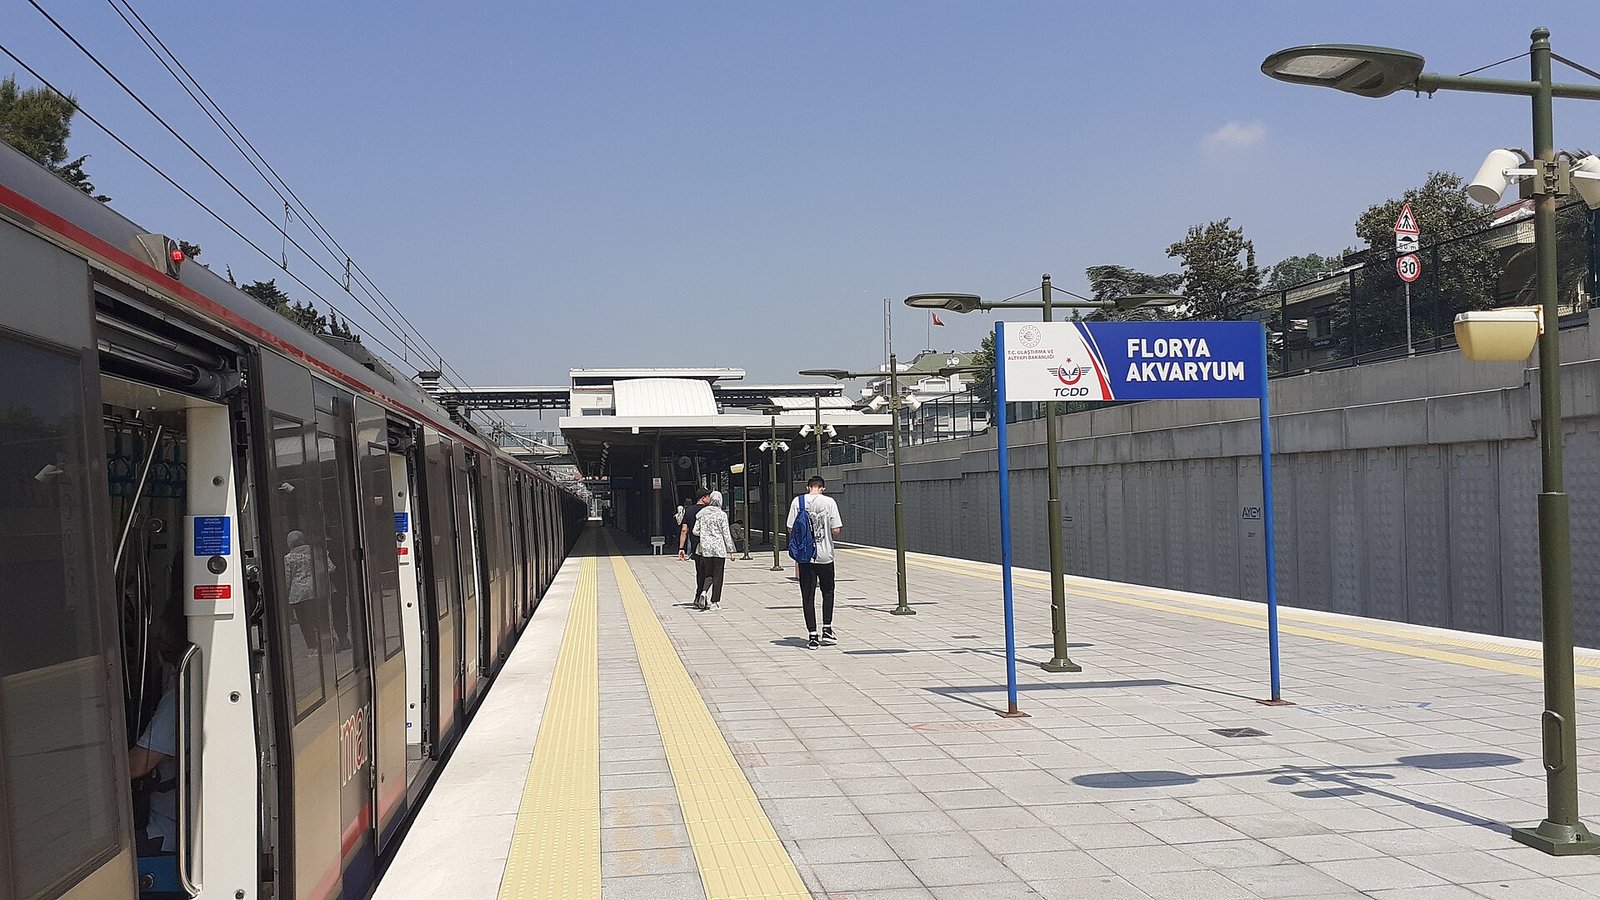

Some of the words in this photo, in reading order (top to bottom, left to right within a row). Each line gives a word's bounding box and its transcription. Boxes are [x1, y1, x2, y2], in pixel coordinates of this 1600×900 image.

[1401, 261, 1416, 274] 30
[1127, 338, 1211, 358] FLORYA
[1126, 361, 1245, 382] AKVARYUM
[1053, 387, 1089, 397] TCDD
